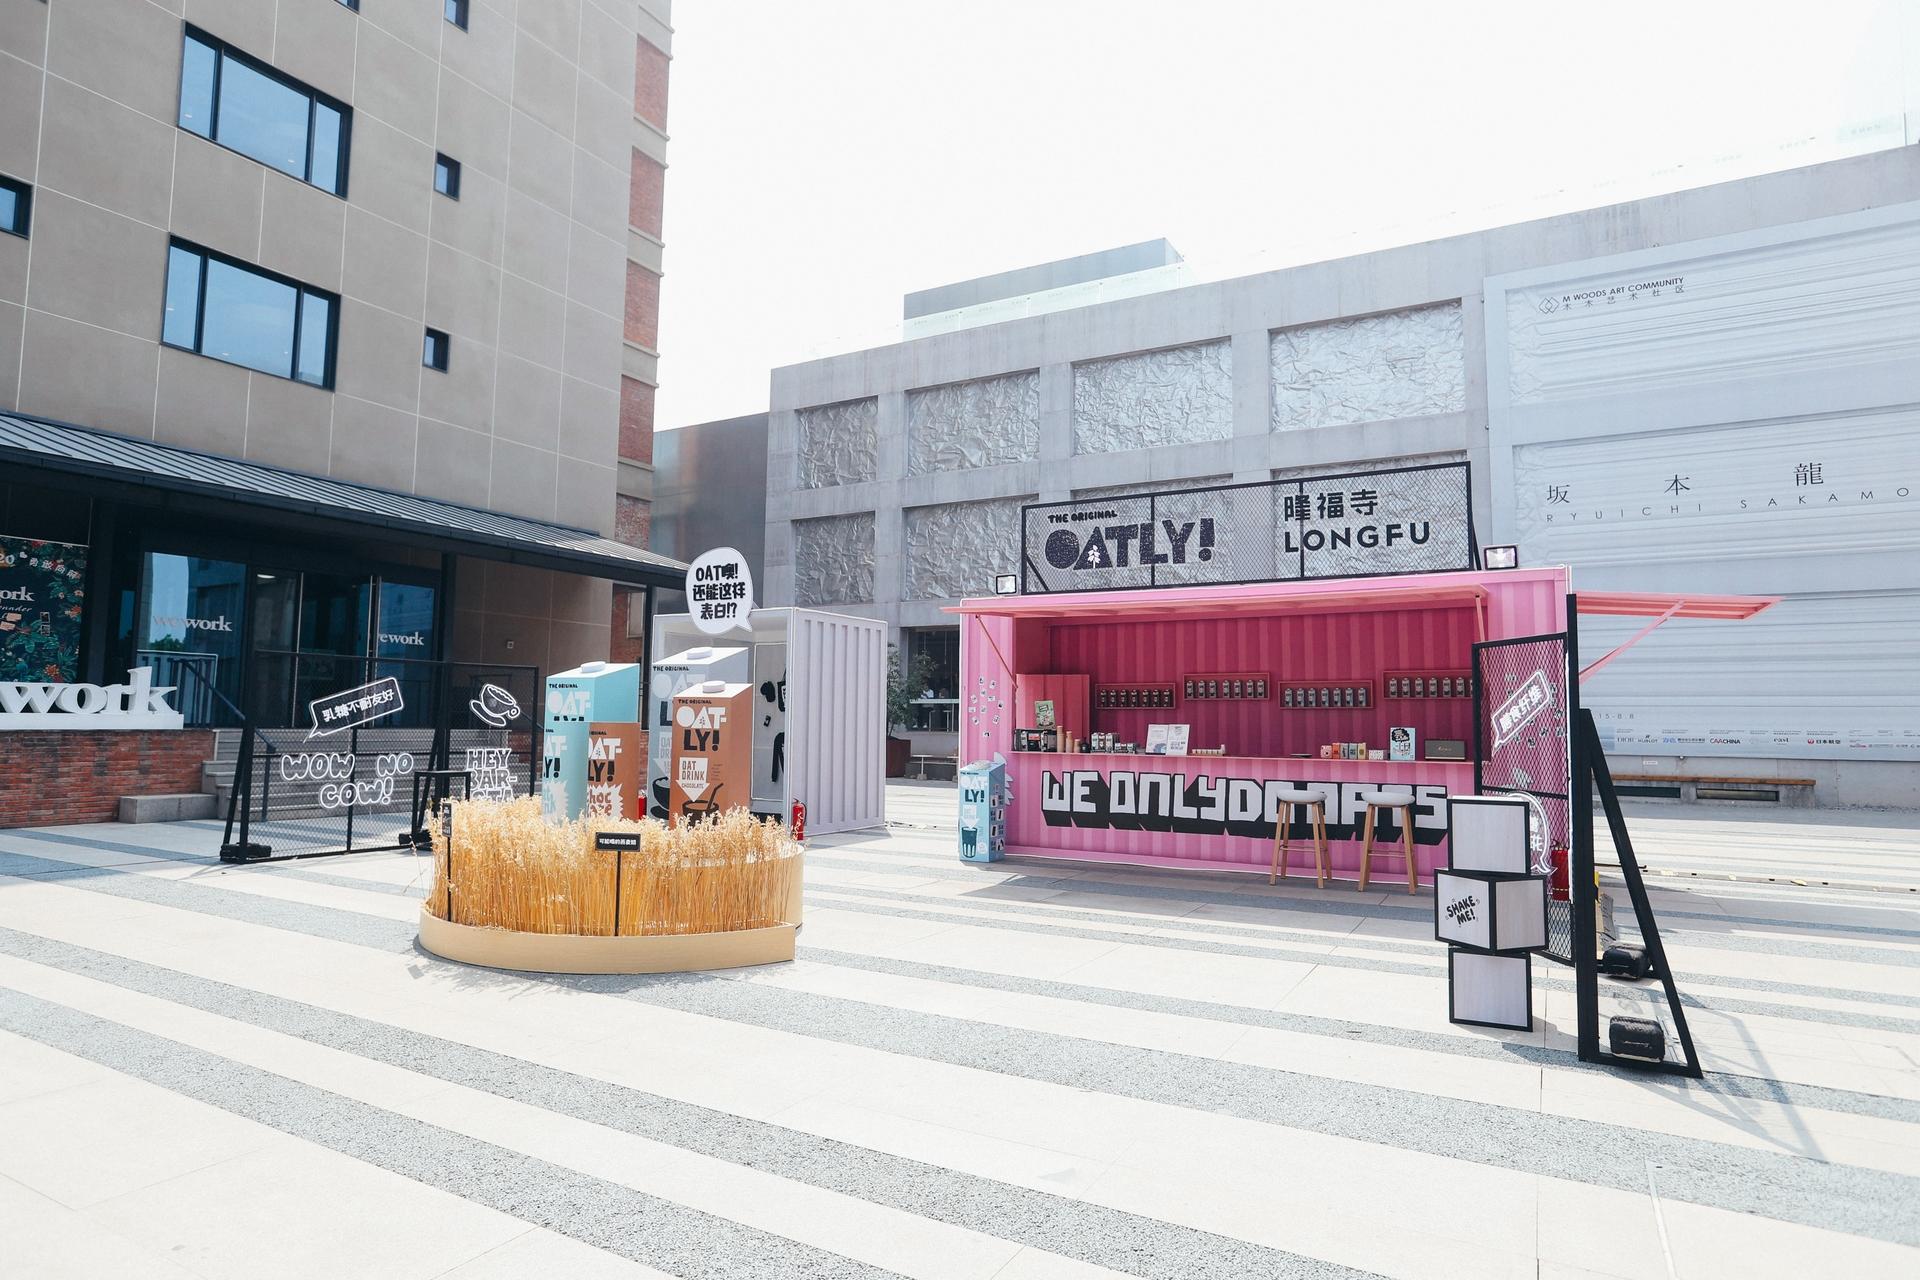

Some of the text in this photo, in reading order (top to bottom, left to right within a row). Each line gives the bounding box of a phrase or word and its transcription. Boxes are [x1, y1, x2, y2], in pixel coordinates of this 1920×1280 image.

[1573, 289, 1607, 301] WOODS
[1609, 286, 1626, 295] ART
[1628, 277, 1685, 292] COMMUNITY
[1284, 488, 1378, 521] 隆福寺
[1546, 487, 1909, 522] RYUICHI SAKAMO
[1047, 509, 1118, 524] THE ORIGINAL
[1045, 518, 1216, 571] OATLY!
[1284, 521, 1430, 553] LONGFU
[692, 581, 746, 602] 还能这样
[684, 729, 721, 752] LY!
[281, 752, 415, 780] WOW NO
[466, 748, 513, 770] HEY
[681, 770, 706, 782] DRINK
[320, 775, 394, 809] COW!
[964, 789, 985, 803] LY!
[1042, 771, 1104, 820] WE
[1446, 895, 1476, 918] SHAKE
[1456, 908, 1476, 925] ME!
